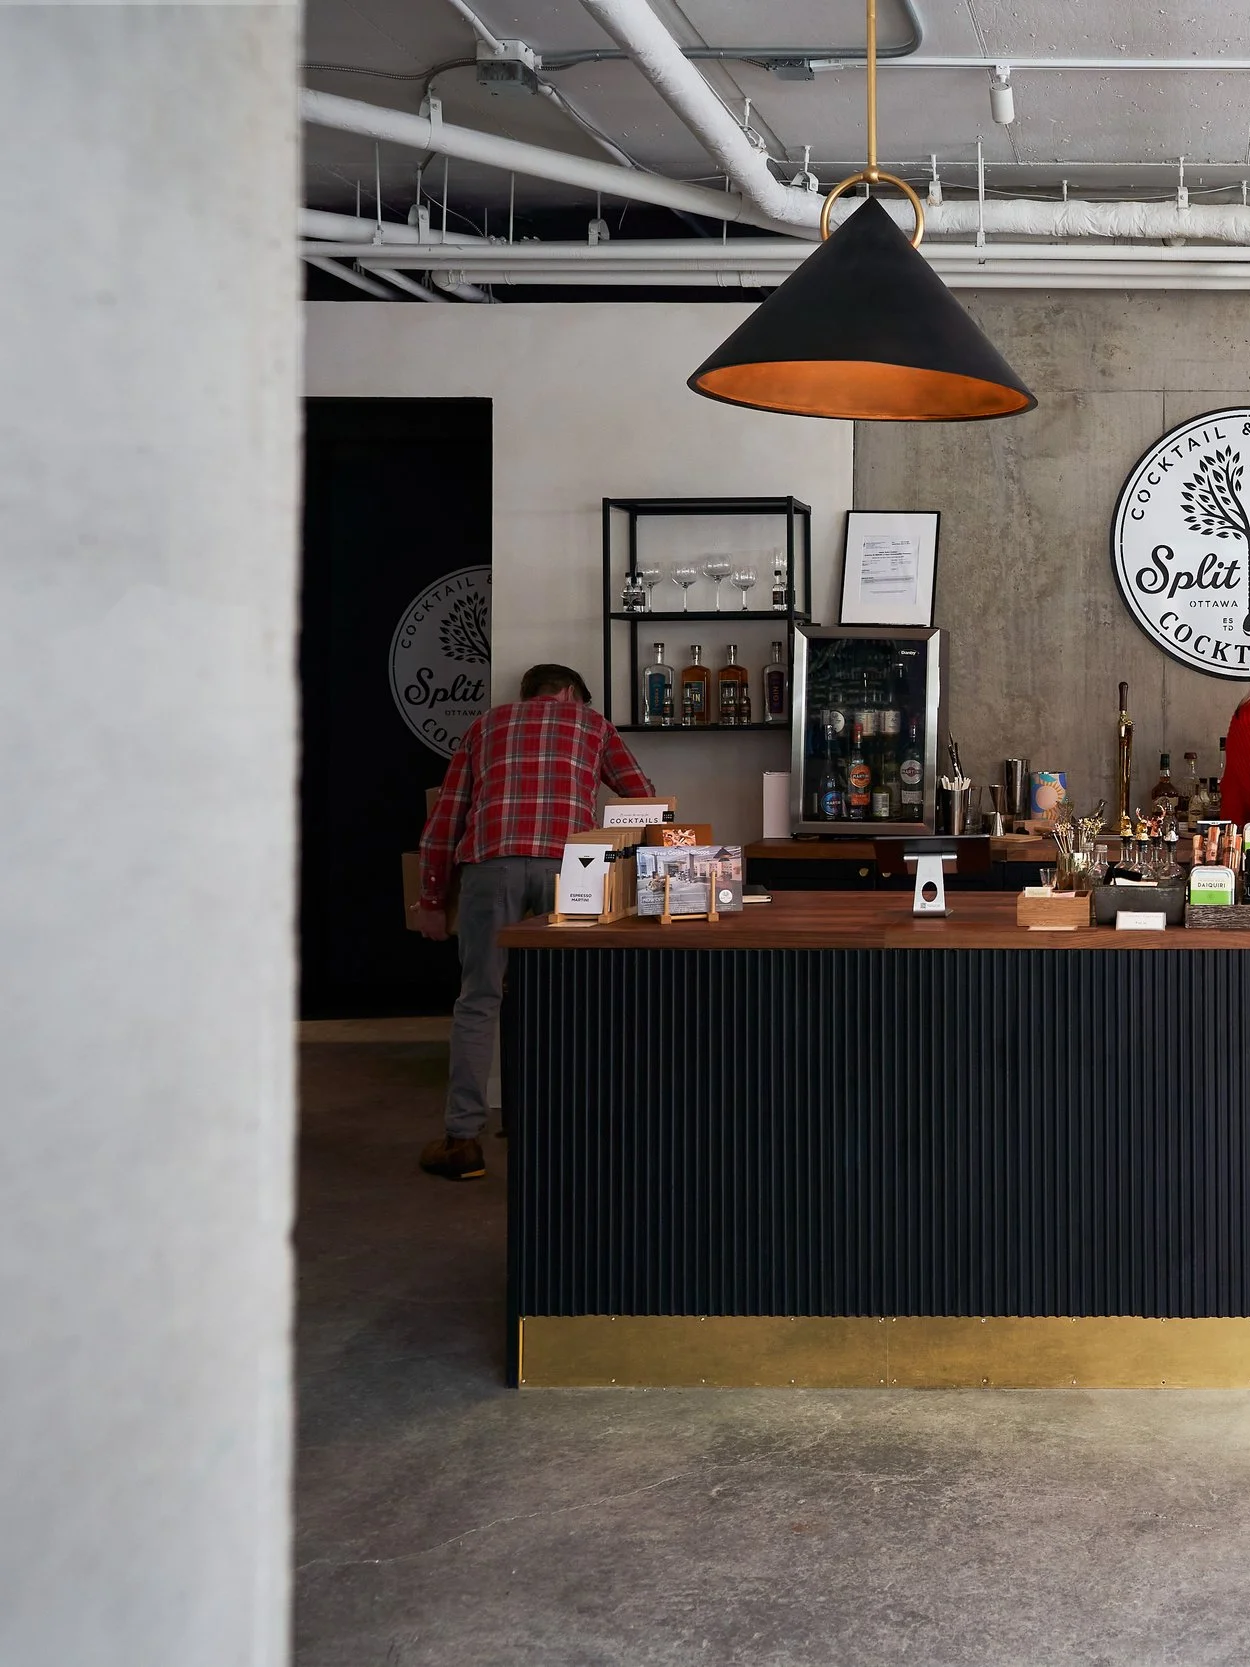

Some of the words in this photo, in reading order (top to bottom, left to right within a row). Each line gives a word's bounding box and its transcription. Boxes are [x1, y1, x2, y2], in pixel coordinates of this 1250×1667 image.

[1131, 427, 1226, 520] COCKTAIL
[1136, 545, 1241, 599] Split
[401, 577, 474, 649] COCKTAIL
[1190, 600, 1238, 608] OTTAWA
[404, 668, 485, 709] Split
[692, 693, 700, 702] IN
